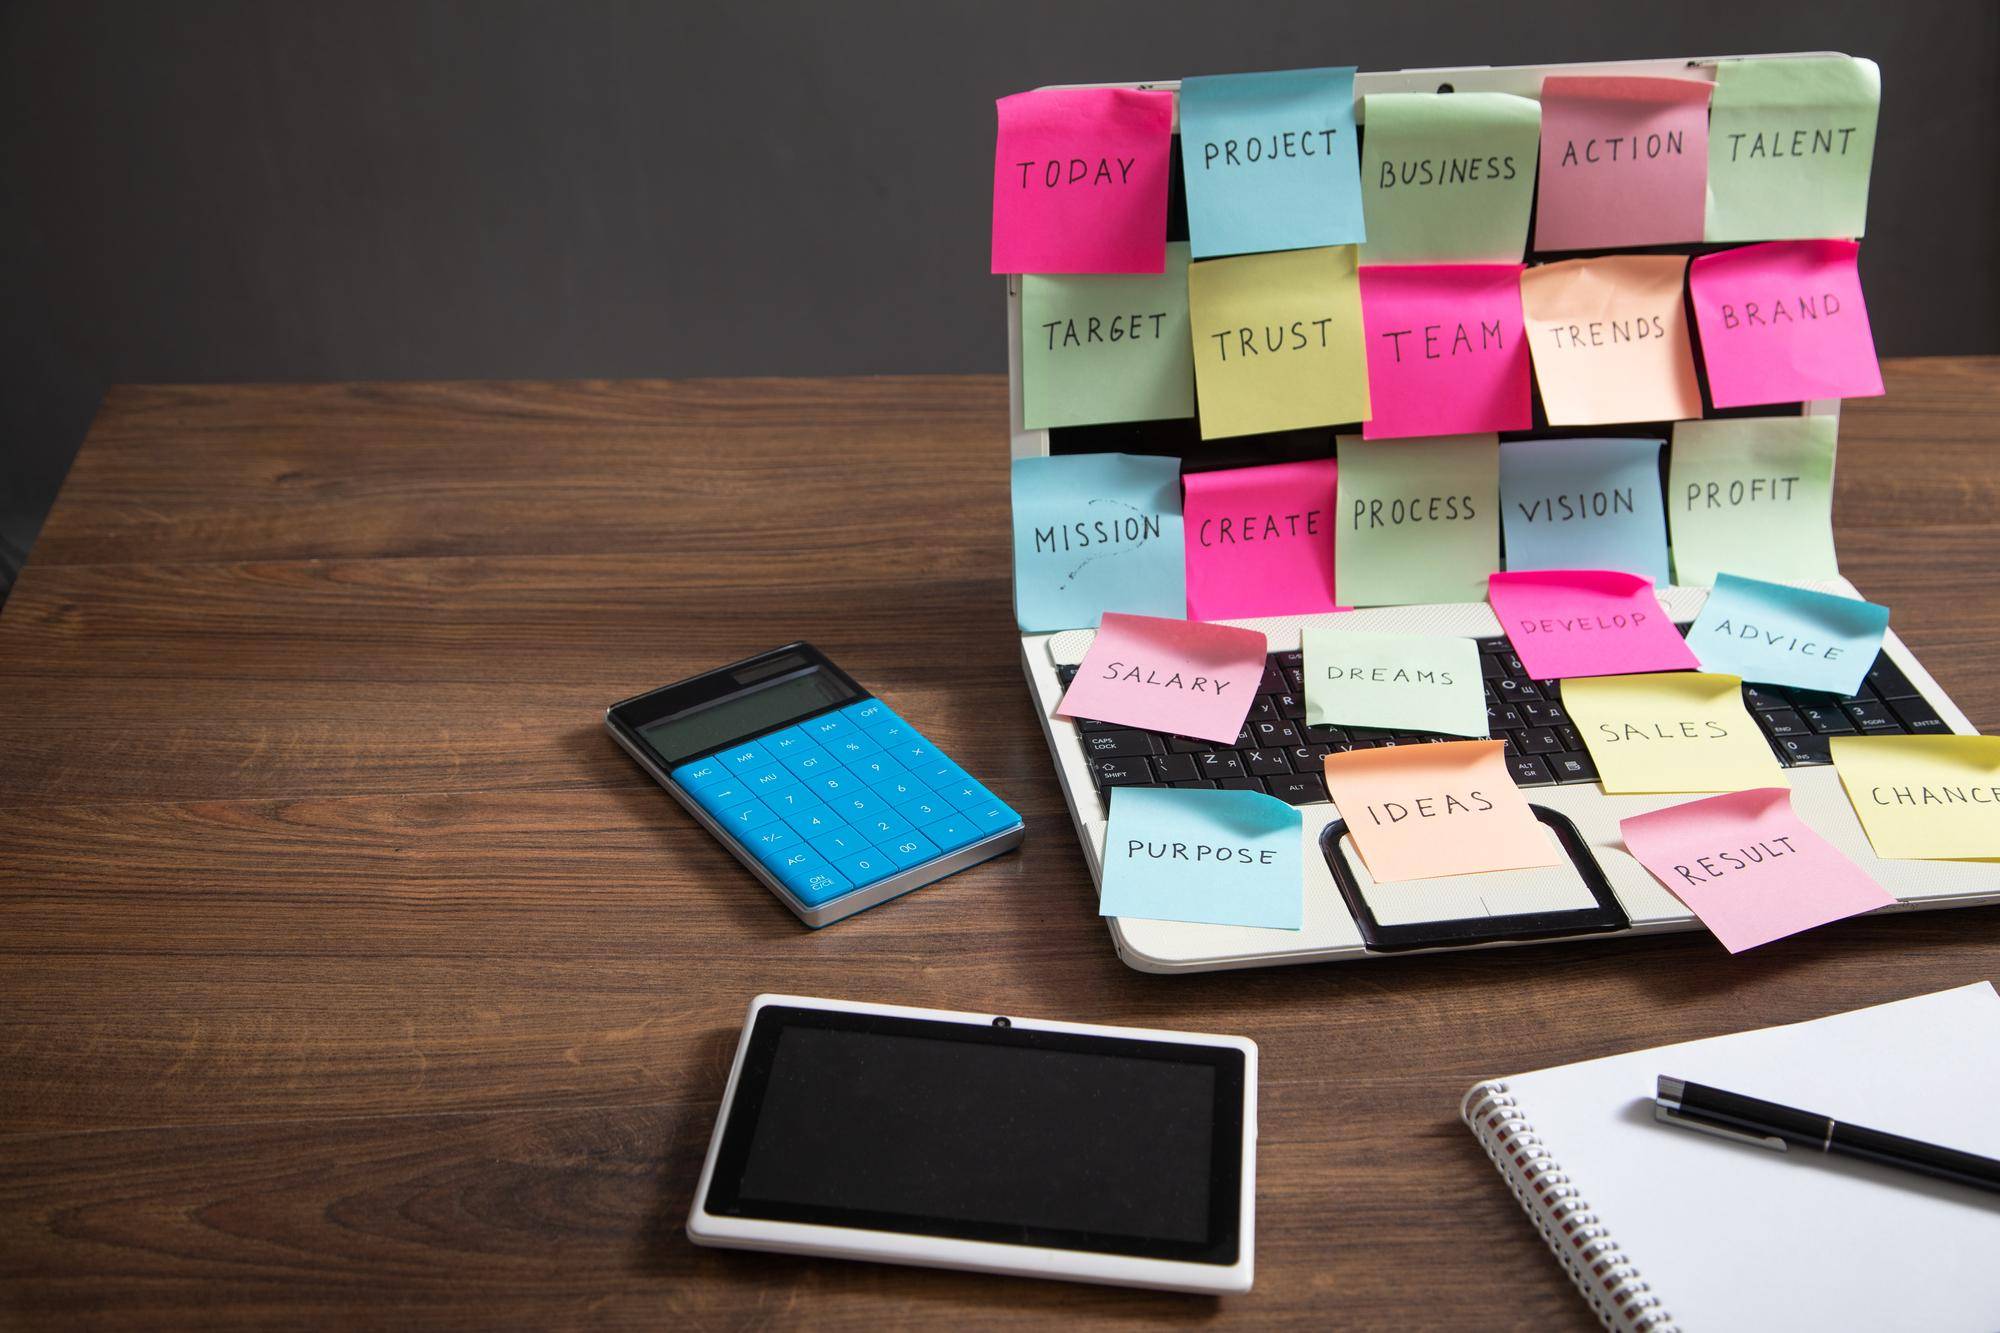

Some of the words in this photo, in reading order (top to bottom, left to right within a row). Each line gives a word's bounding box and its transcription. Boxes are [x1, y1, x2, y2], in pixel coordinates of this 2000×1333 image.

[1204, 129, 1337, 170] PROJECT
[1562, 131, 1684, 167] ACTION
[1728, 128, 1857, 162] TALENT
[1017, 158, 1135, 188] TODAY
[1379, 156, 1517, 188] BUSINESS
[1722, 294, 1841, 329] BRAND
[1042, 313, 1167, 350] TARGET
[1212, 318, 1332, 361] TRUST
[1382, 320, 1503, 362] TEAM
[1549, 316, 1665, 348] TRENDS
[1518, 488, 1634, 523] VISION
[1687, 477, 1800, 511] PROFIT
[1354, 496, 1476, 530] PROCESS
[1035, 514, 1160, 553] MISSION
[1200, 511, 1321, 548] CREATE
[1521, 612, 1647, 635] DEVELOP
[1715, 620, 1844, 661] ADVICE
[1102, 662, 1230, 696] SALARY
[1327, 666, 1454, 686] DREAMS
[861, 707, 878, 716] OFF
[1283, 697, 1294, 705] R
[1527, 705, 1537, 713] L
[1853, 707, 1864, 716] 3
[1766, 714, 1775, 722] 1
[1810, 711, 1821, 719] 2
[1913, 719, 1940, 727] ENTER
[1260, 724, 1274, 733] D
[1600, 720, 1728, 742] SALES
[737, 753, 753, 762] MR
[804, 758, 817, 766] GT
[1204, 755, 1218, 763] Z
[693, 769, 711, 778] MC
[760, 774, 776, 783] MU
[1104, 771, 1127, 779] SHIFT
[1367, 791, 1493, 825] IDEAS
[788, 855, 805, 865] AC
[1128, 840, 1278, 865] PURPOSE
[1674, 836, 1797, 886] RESULT
[810, 875, 825, 884] ON
